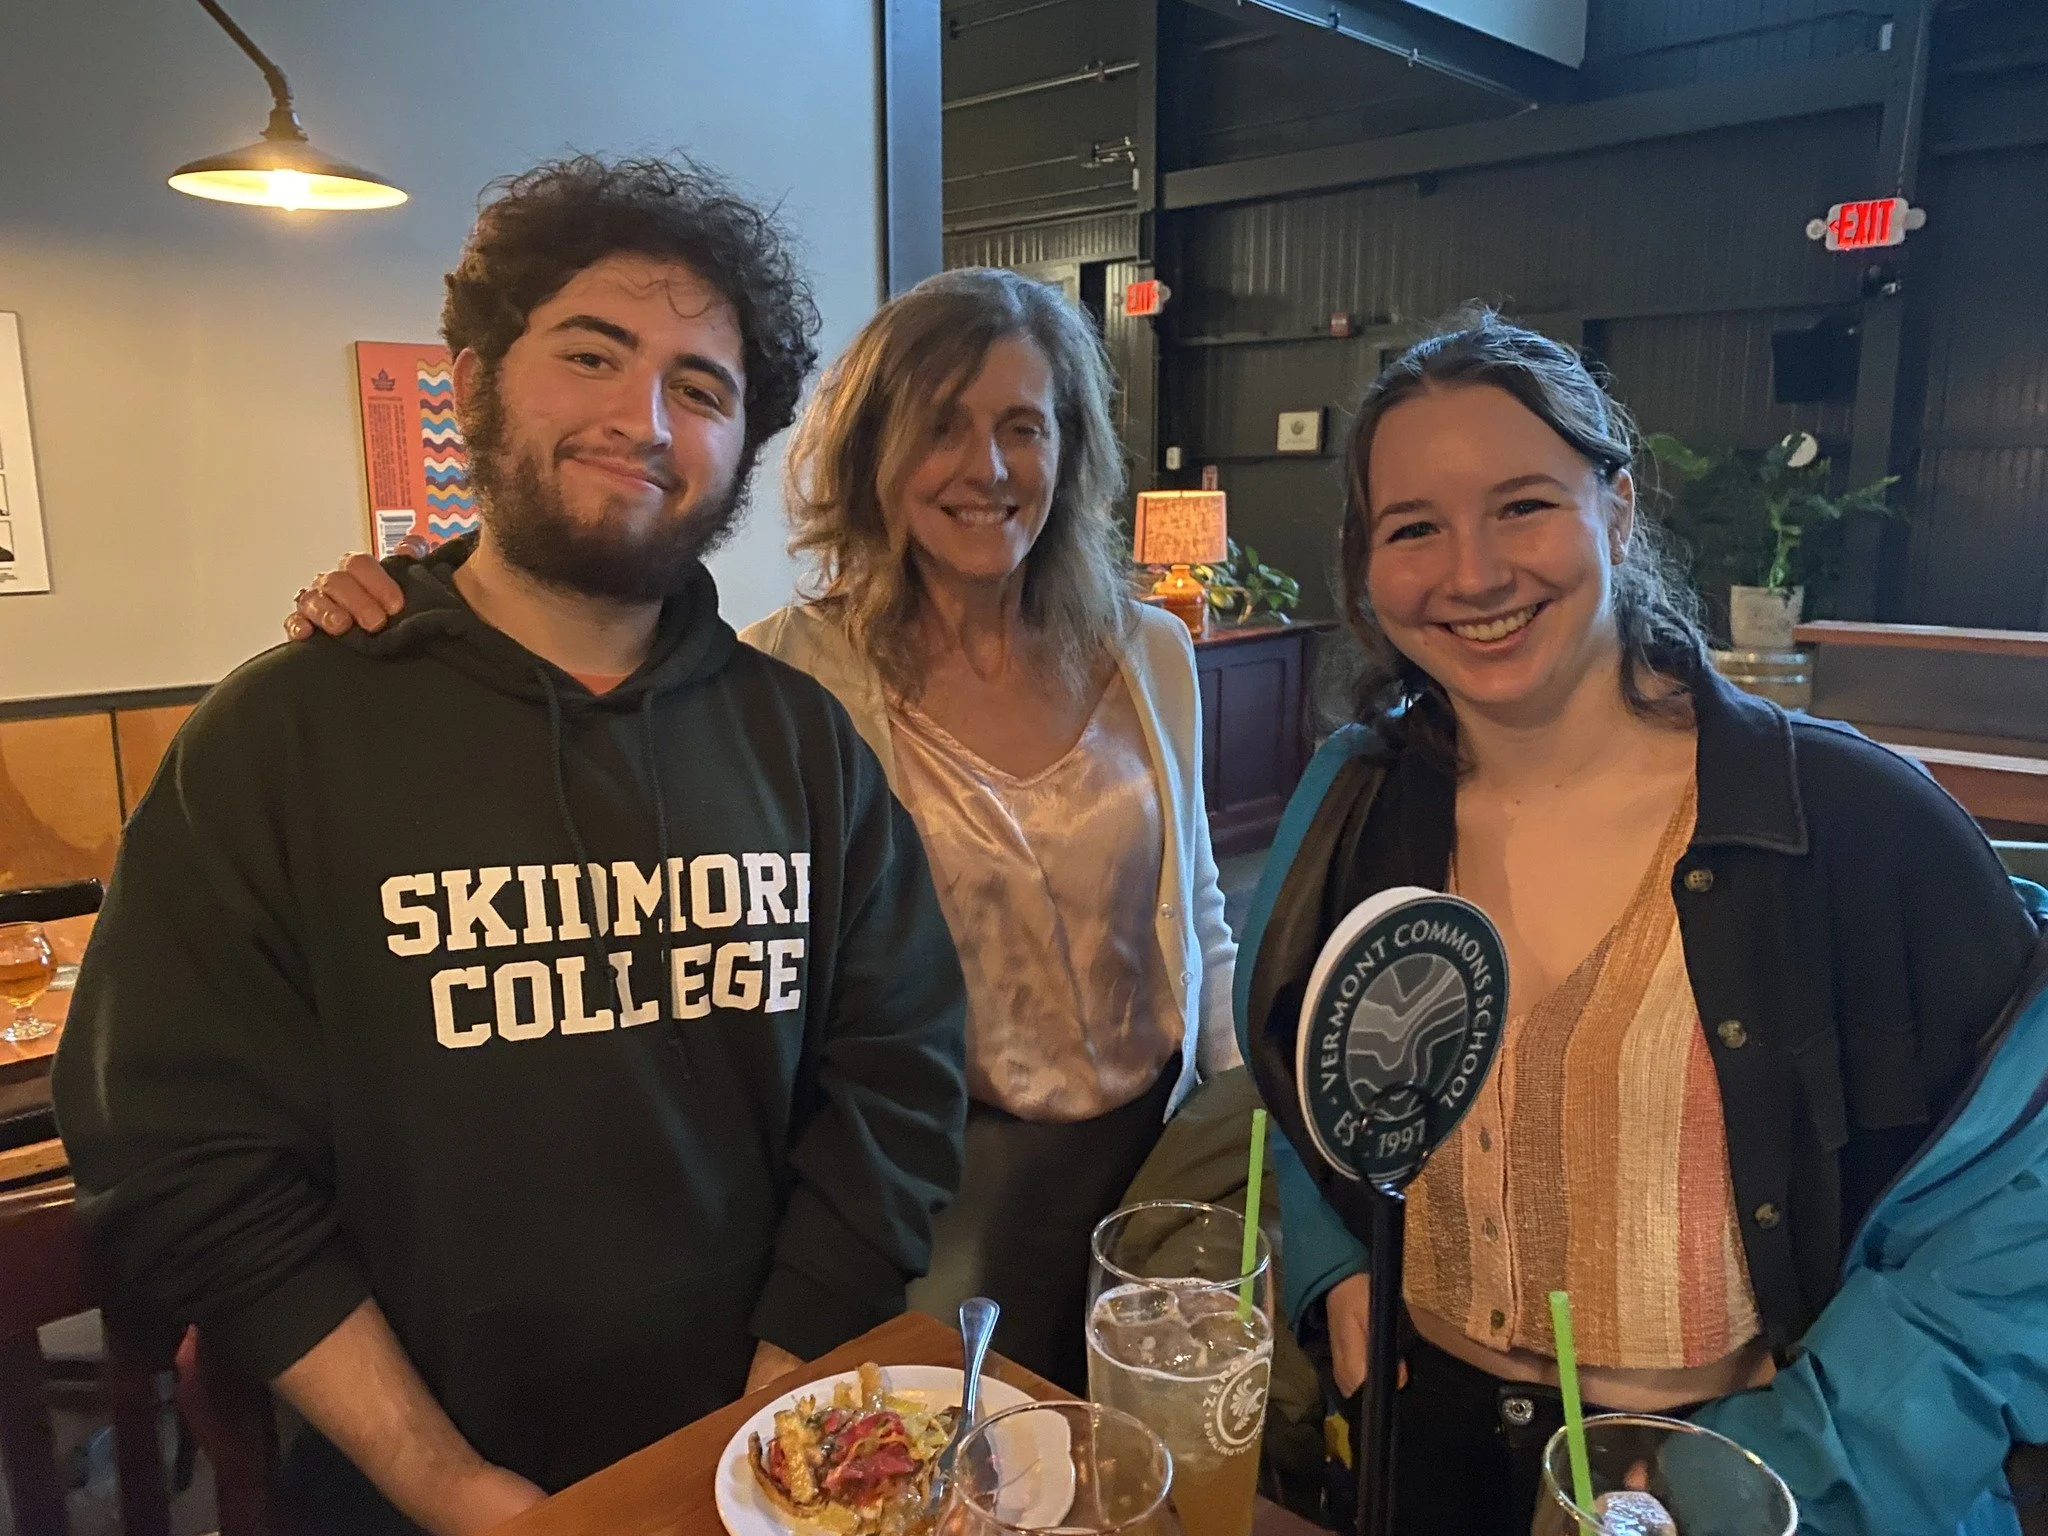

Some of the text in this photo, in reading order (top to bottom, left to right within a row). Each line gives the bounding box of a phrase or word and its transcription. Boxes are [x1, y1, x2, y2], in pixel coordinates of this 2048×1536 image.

[1838, 200, 1895, 246] EXIT
[430, 938, 806, 1049] COLLEGE
[1321, 919, 1494, 1109] VERMONT COMMONS SCHOOL
[1378, 1117, 1426, 1158] 1997
